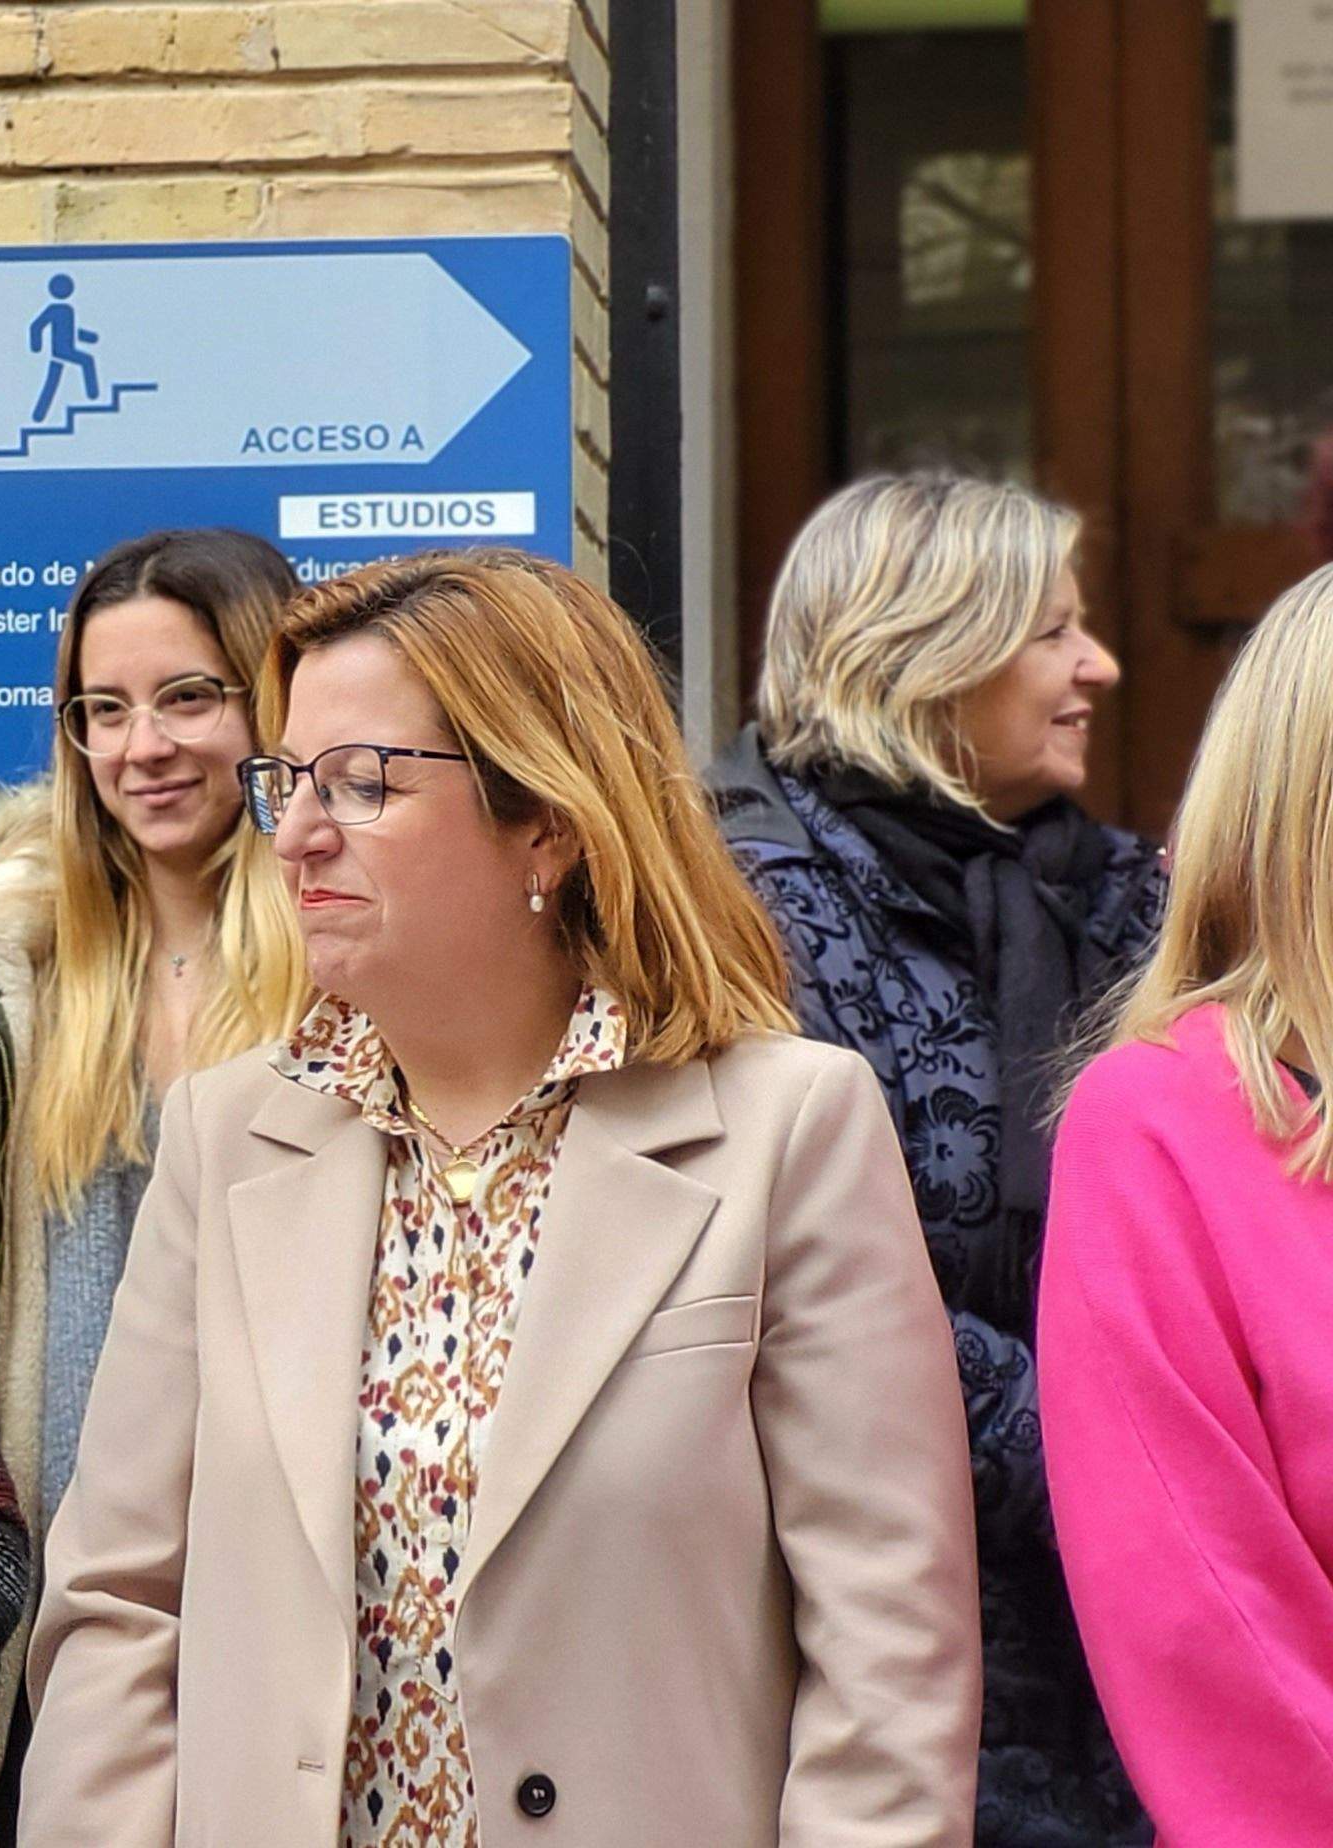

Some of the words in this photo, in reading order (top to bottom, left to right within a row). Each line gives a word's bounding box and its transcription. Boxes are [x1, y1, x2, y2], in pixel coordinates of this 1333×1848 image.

[240, 424, 390, 453] ACCESO
[400, 424, 425, 450] A
[317, 500, 496, 529] ESTUDIOS
[42, 560, 77, 587] de
